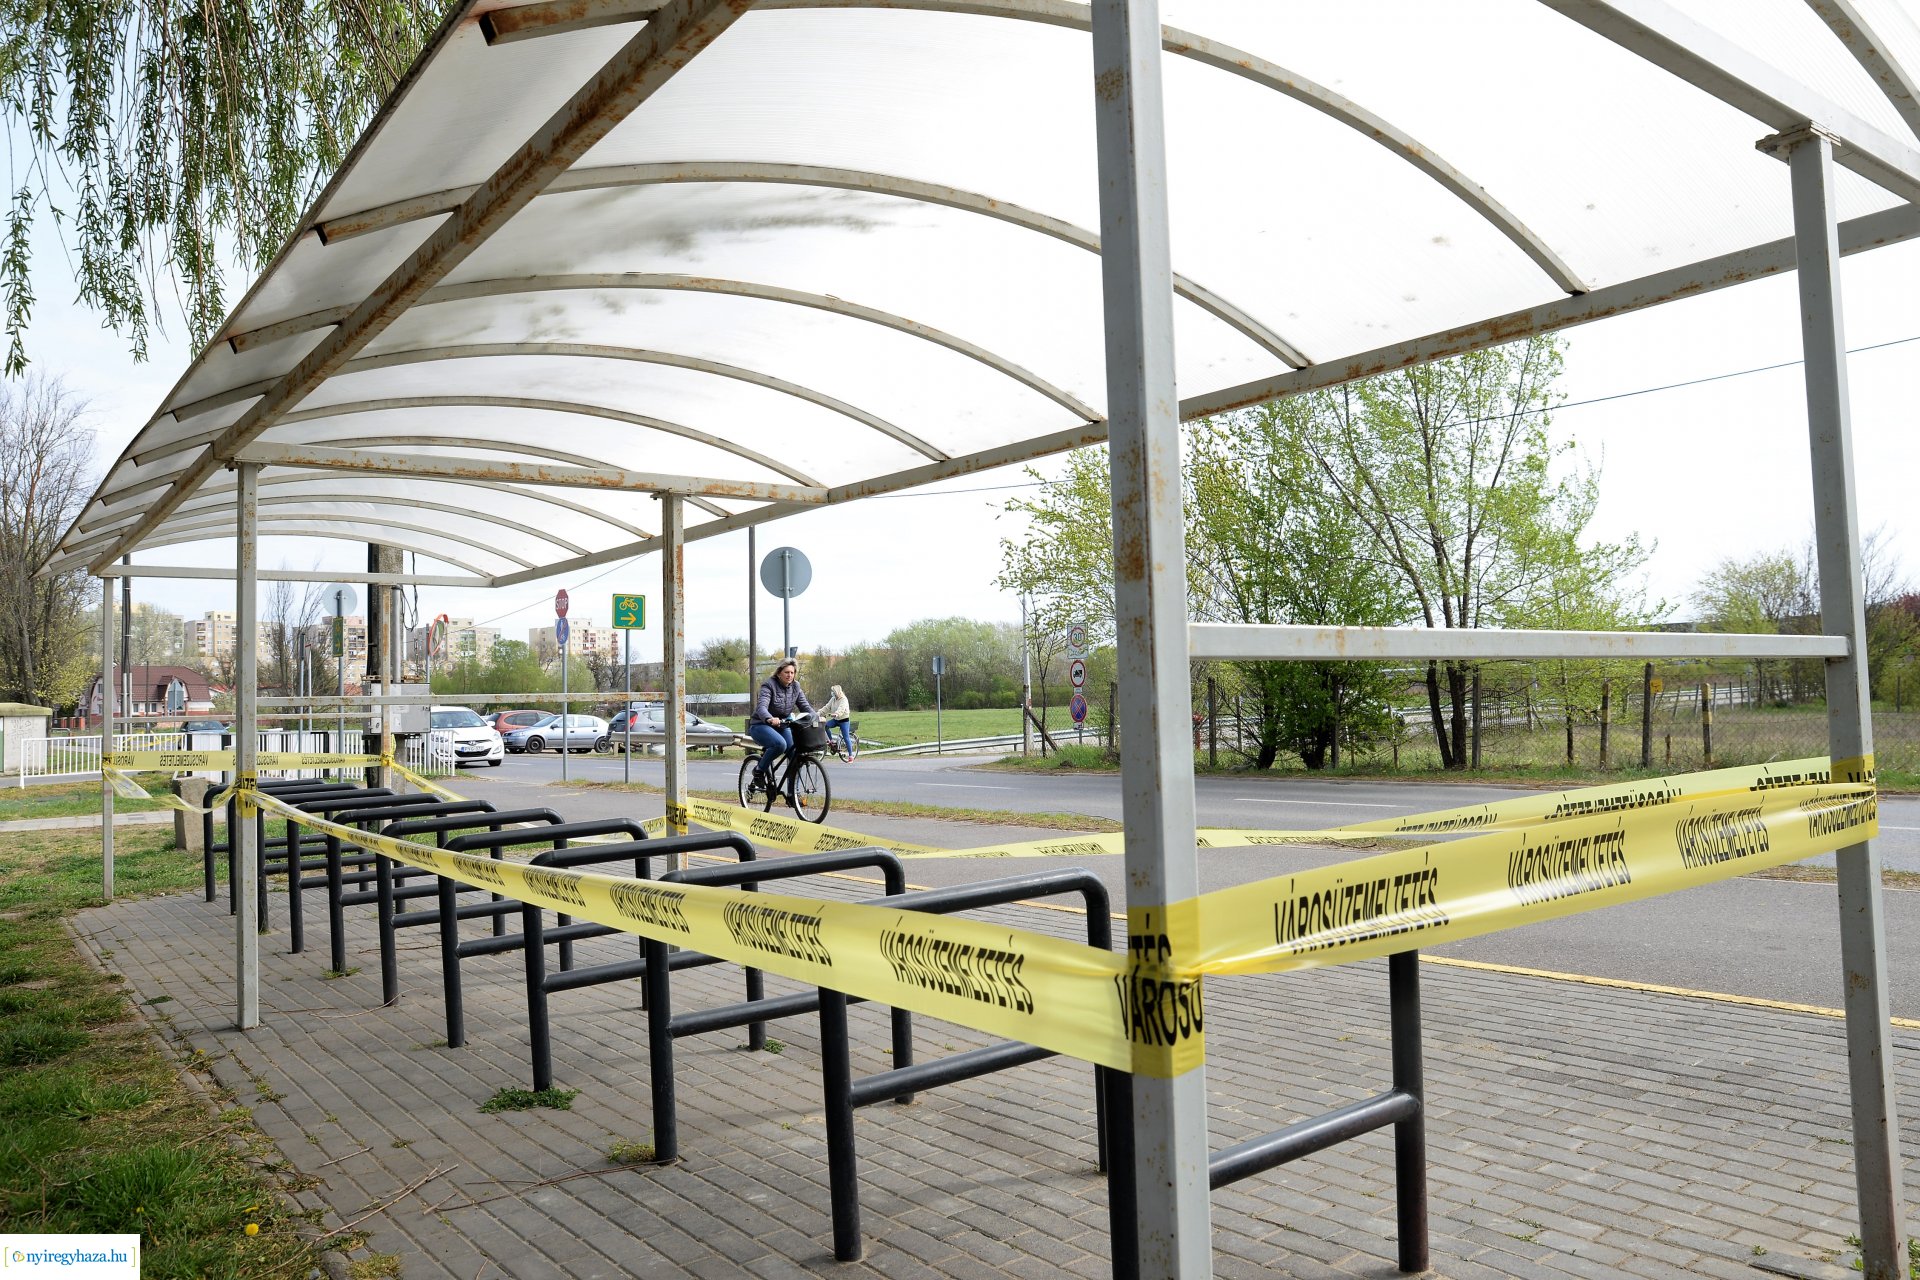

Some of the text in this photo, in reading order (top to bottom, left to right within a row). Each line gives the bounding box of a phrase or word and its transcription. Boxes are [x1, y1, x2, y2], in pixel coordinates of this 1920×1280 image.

[556, 598, 568, 610] STOP
[1274, 851, 1450, 955] VÁROSÜZEMELTETÉS
[1508, 815, 1632, 907] VÁROSÜZEMELTETÉS
[1675, 794, 1770, 870] VÁROSÜZEMELTETÉS
[880, 915, 1034, 1016] VÁROSÜZEMELTETÉS
